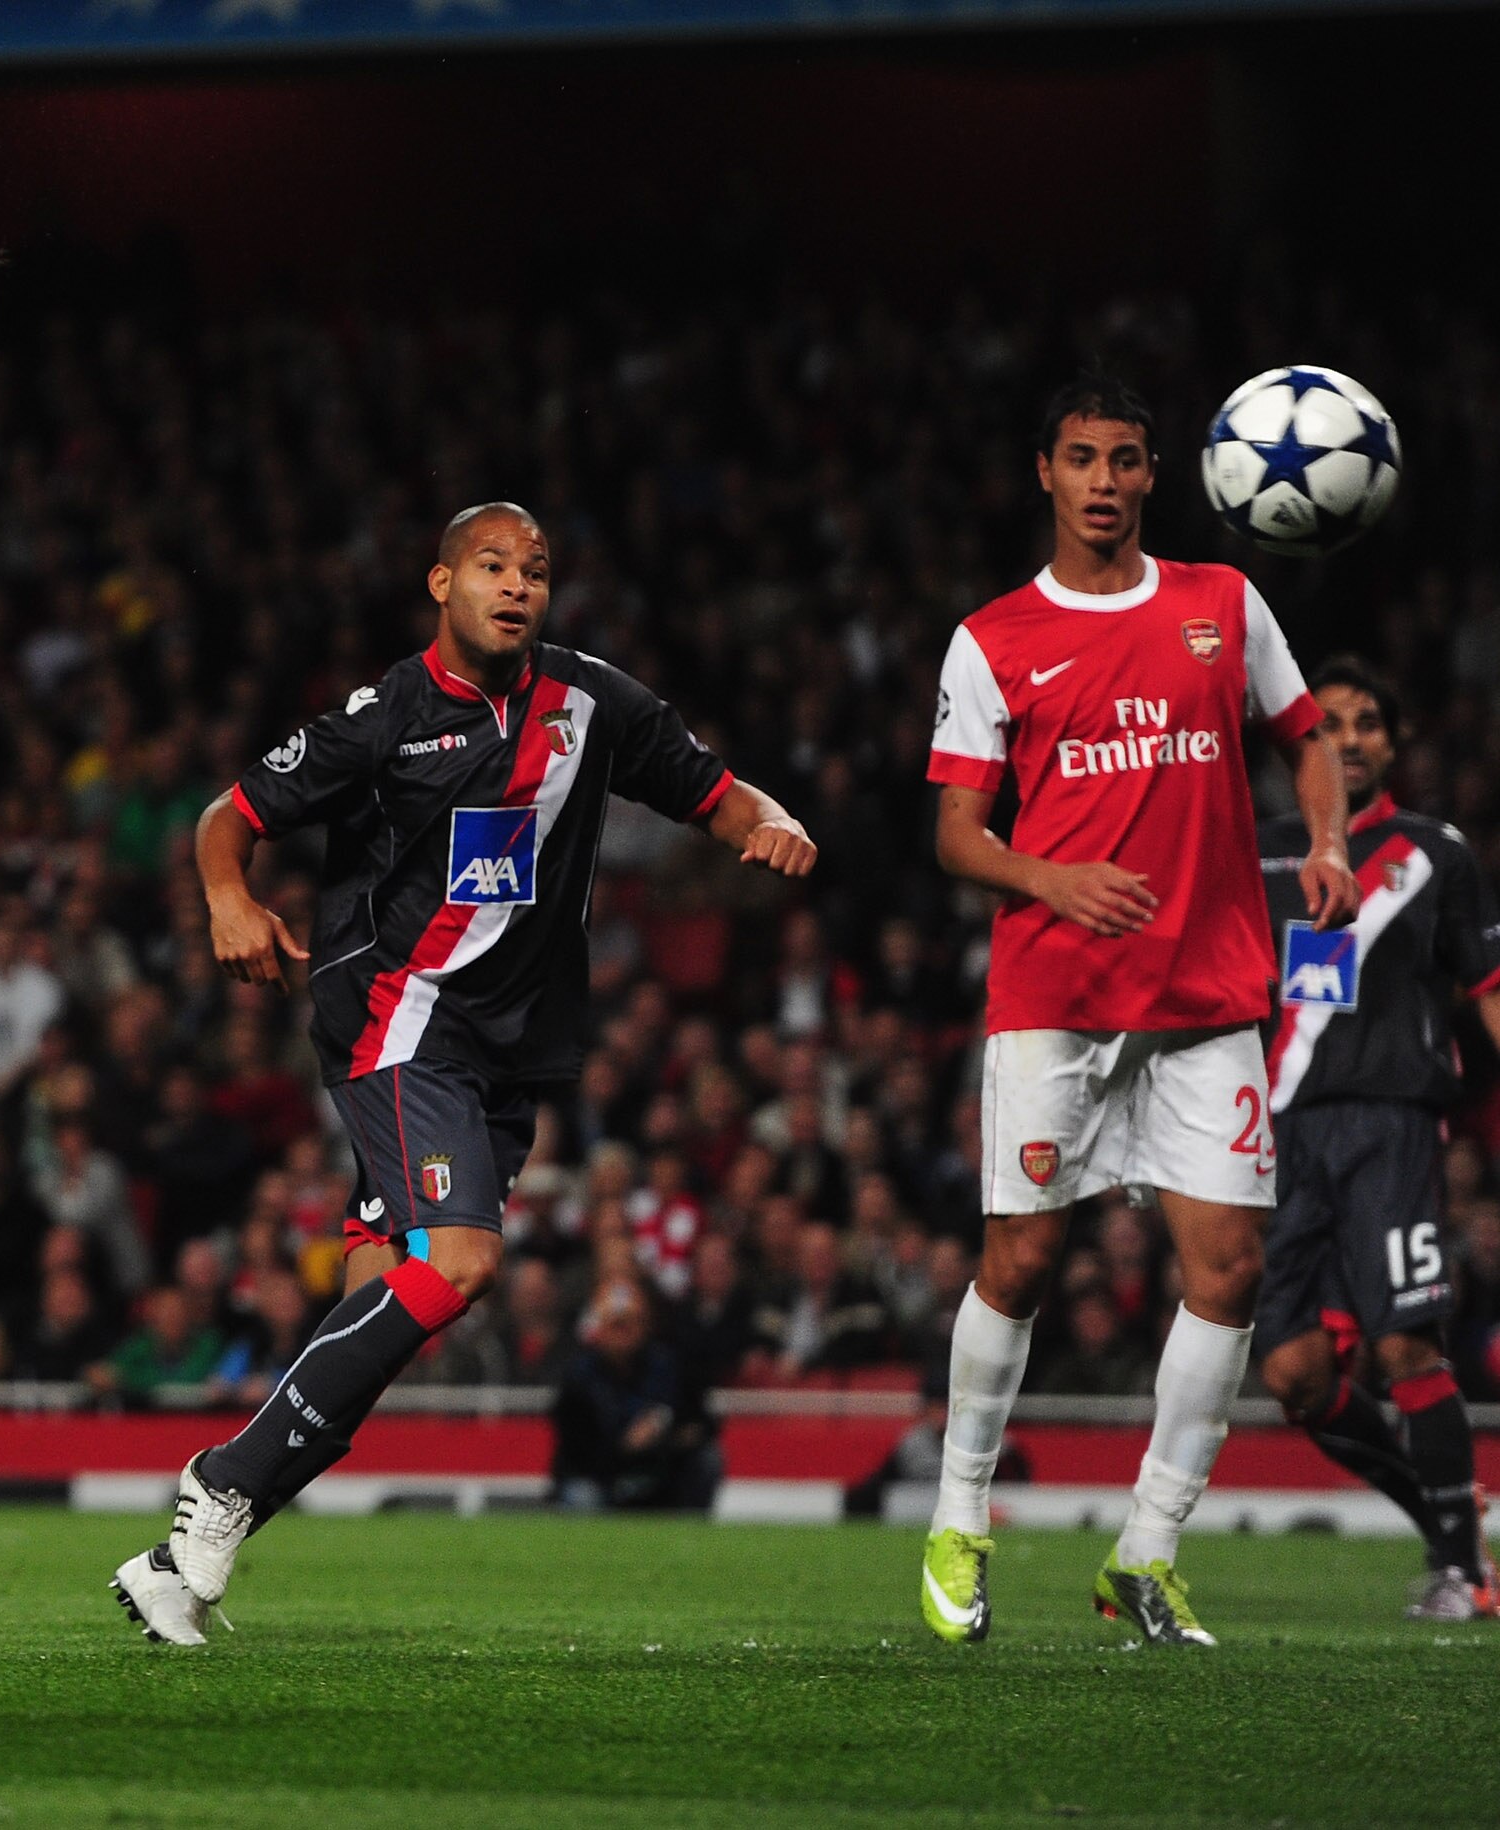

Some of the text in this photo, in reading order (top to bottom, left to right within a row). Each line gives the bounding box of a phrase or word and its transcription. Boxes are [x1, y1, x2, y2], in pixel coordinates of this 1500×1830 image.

[1114, 696, 1169, 729] Fly
[1056, 729, 1220, 779] Emirates
[449, 856, 520, 895] AXA
[1229, 1085, 1277, 1158] 2
[1387, 1222, 1442, 1289] 15
[286, 1383, 305, 1409] SC
